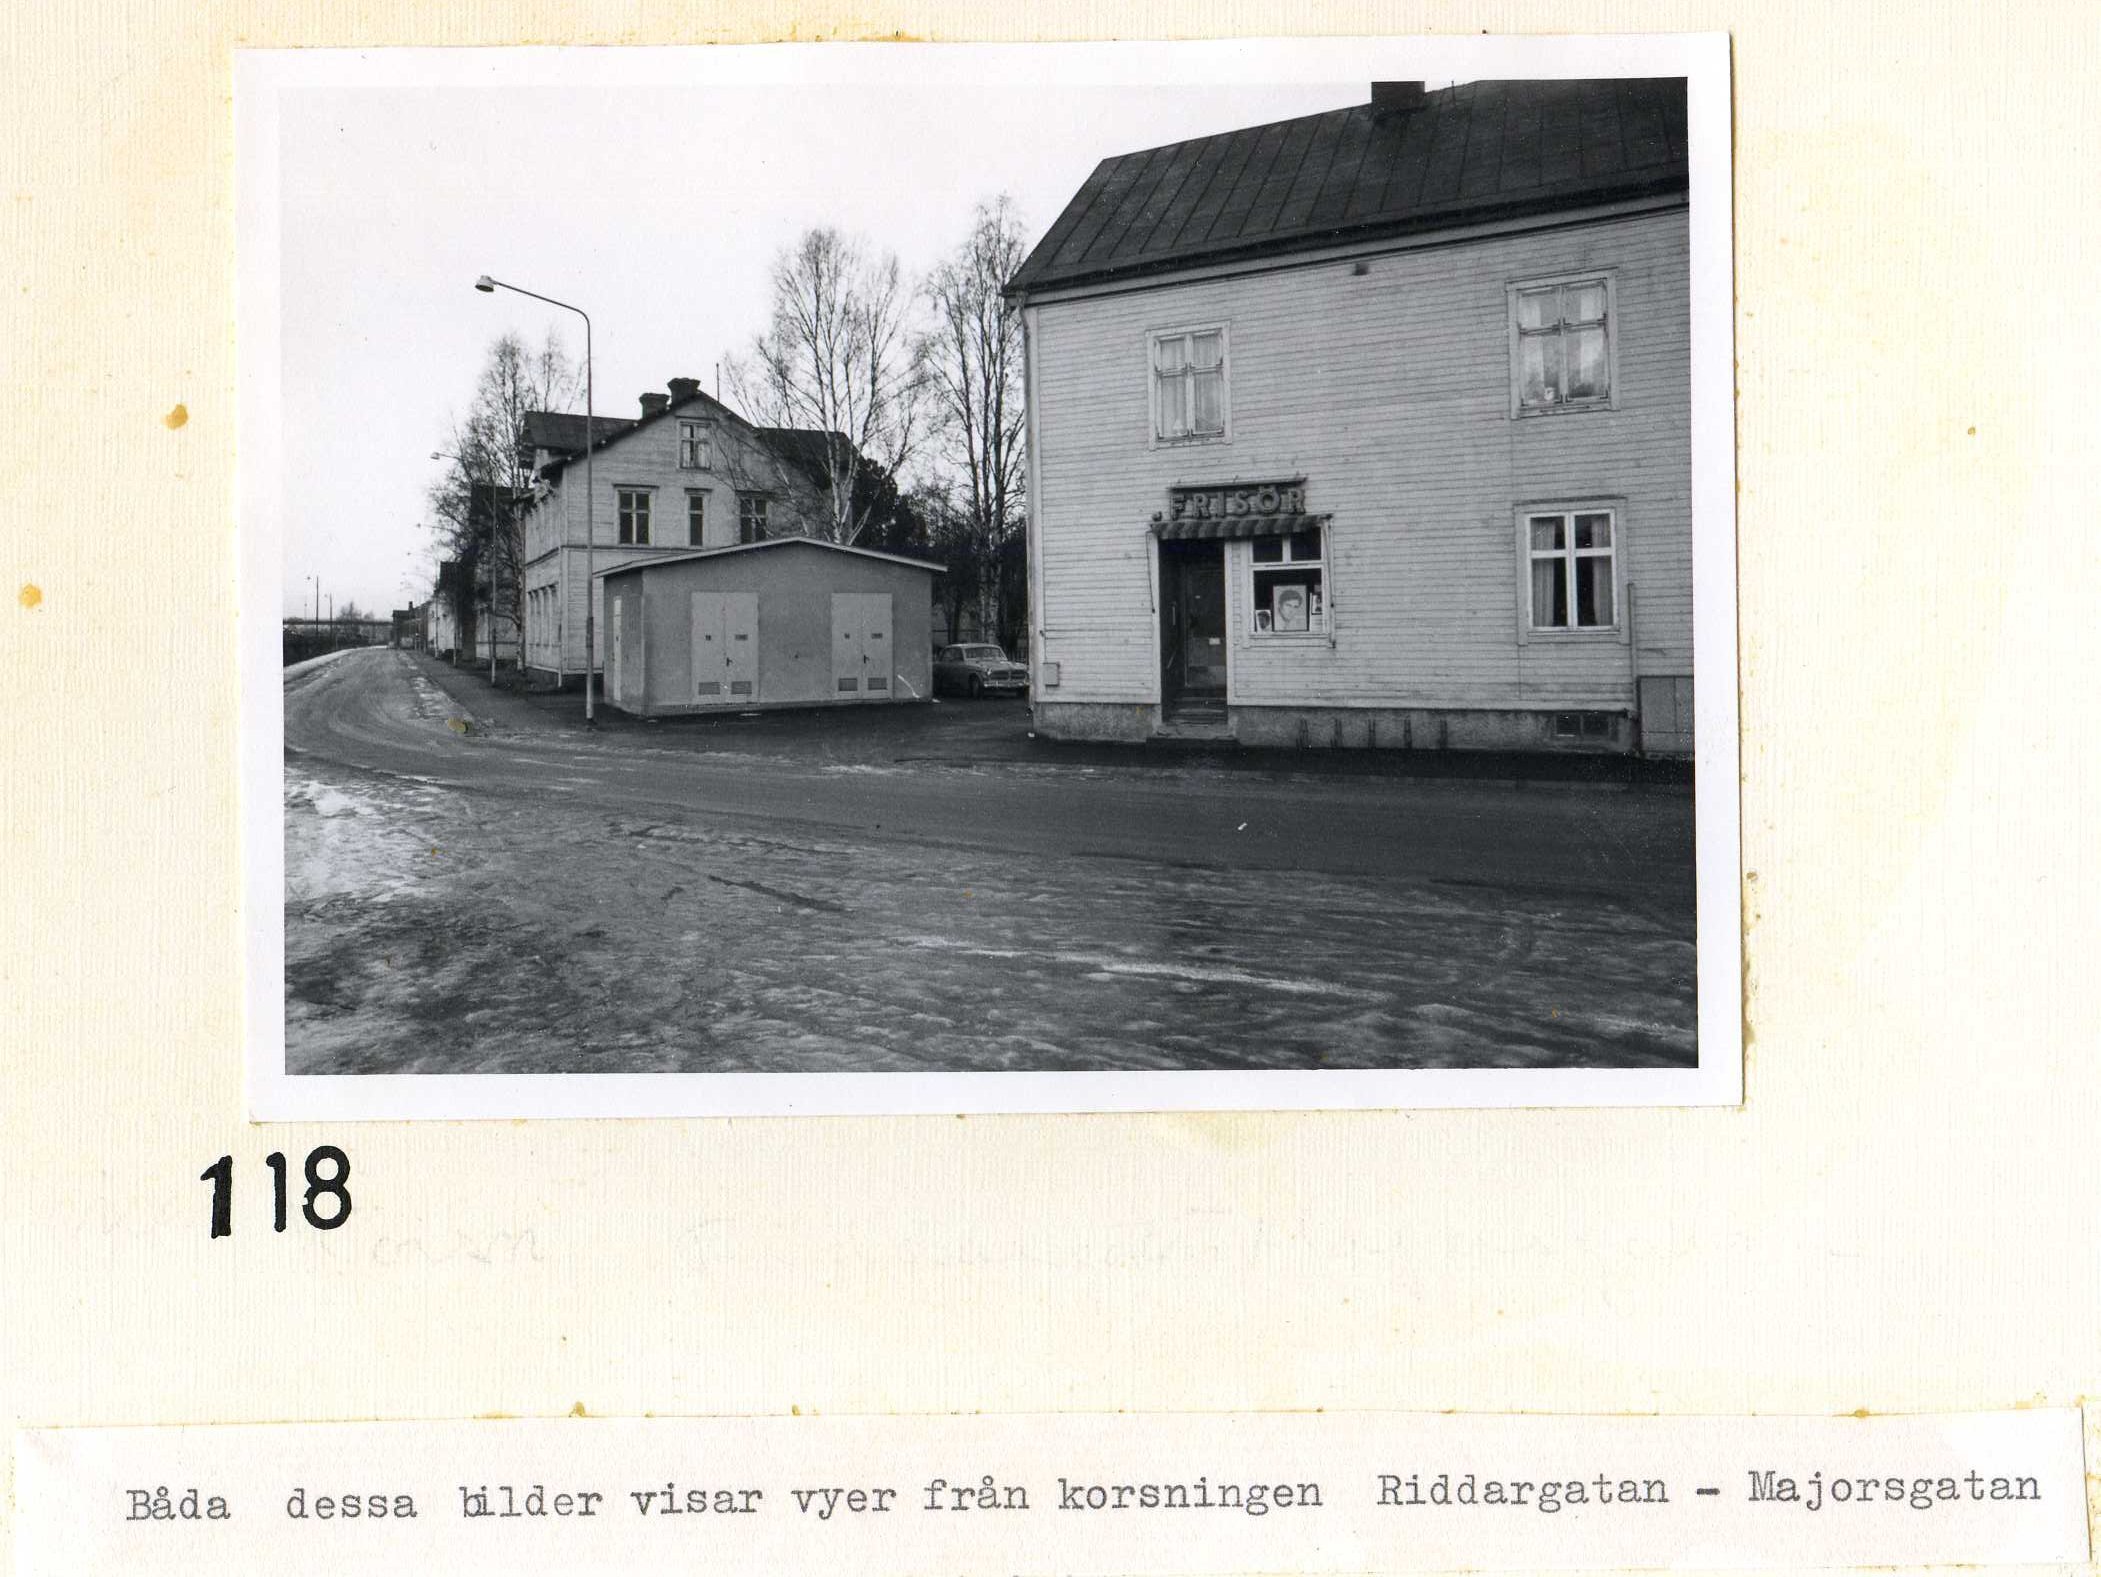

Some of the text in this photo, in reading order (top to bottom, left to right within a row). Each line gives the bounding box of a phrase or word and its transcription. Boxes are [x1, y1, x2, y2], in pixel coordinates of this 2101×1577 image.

[1171, 486, 1306, 521] FRISÖR
[201, 1146, 352, 1239] 118
[127, 1486, 230, 1520] Båda
[287, 1488, 417, 1520] dessa
[460, 1485, 602, 1518] bilder
[631, 1482, 762, 1516] visar
[791, 1488, 896, 1520] vyer
[924, 1475, 1030, 1511] från
[1057, 1476, 1323, 1516] korsningen
[1377, 1473, 1669, 1514] Riddargatan
[1748, 1470, 2041, 1512] Majorsgatan
